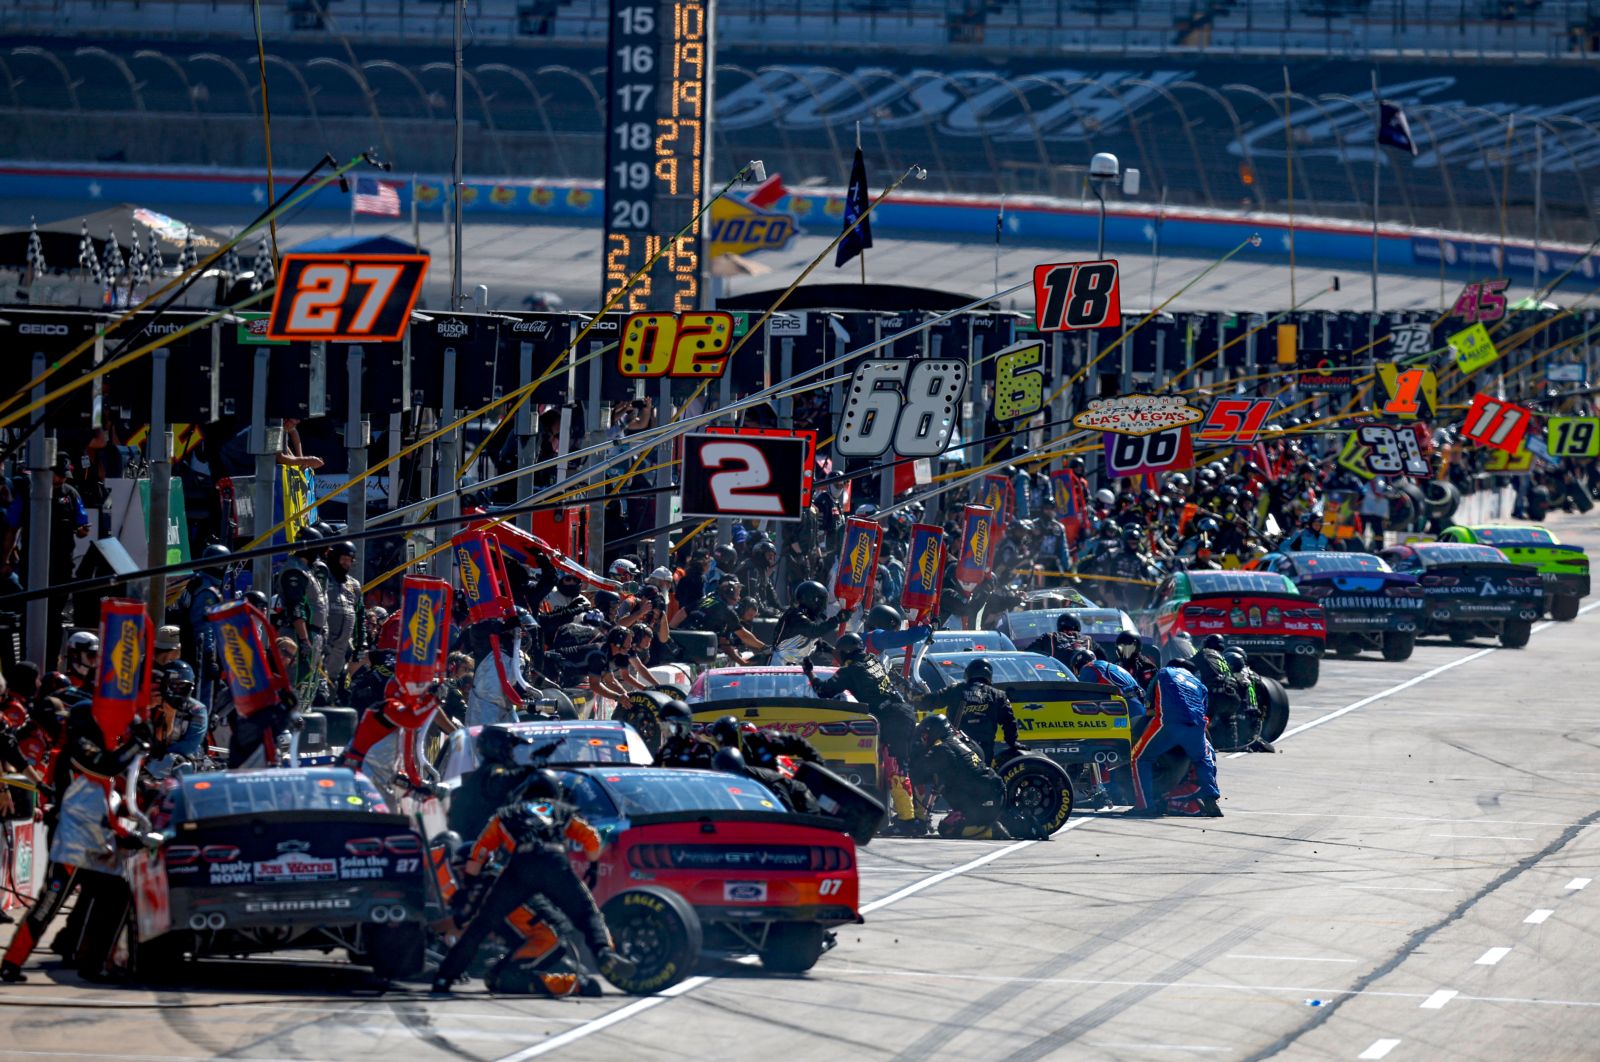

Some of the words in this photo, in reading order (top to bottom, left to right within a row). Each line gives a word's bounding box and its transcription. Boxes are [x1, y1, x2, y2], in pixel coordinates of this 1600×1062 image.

[618, 7, 654, 34] 15
[674, 3, 703, 40] 10
[617, 46, 653, 73] 16
[674, 42, 703, 78] 19
[616, 85, 653, 112] 17
[672, 81, 702, 117] 19
[614, 123, 651, 150] 18
[656, 119, 700, 155] 27
[613, 162, 650, 189] 19
[655, 158, 700, 195] 91
[612, 200, 649, 228] 20
[711, 219, 785, 244] NOCO
[285, 263, 405, 333] 27
[1040, 261, 1118, 330] 18
[1451, 280, 1511, 322] 45
[19, 324, 68, 335] GEICO
[438, 323, 468, 335] BUSCH
[581, 322, 617, 330] GEICO
[772, 320, 801, 329] SRS
[618, 311, 734, 378] 02
[995, 343, 1044, 421] 6
[1383, 368, 1424, 414] 1
[836, 359, 967, 456] 68
[1091, 415, 1120, 425] LAS
[1128, 412, 1187, 422] VEGAS
[1092, 397, 1182, 409] WELCOME
[1200, 399, 1273, 441] 51
[1470, 402, 1523, 445] 11
[1556, 421, 1594, 455] 19
[1112, 430, 1180, 471] 66
[1361, 426, 1429, 474] 31
[700, 441, 785, 514] 2
[852, 533, 870, 584] SUNOCO
[974, 520, 988, 566] SUNOCO
[460, 548, 479, 601] SUNOCO
[922, 537, 938, 590] SUNOCO
[413, 595, 432, 661] SUNOCO
[119, 620, 138, 694] SUNOCO
[222, 624, 256, 689] SUNOCO
[1036, 721, 1075, 729] TRAILER
[1078, 720, 1107, 728] SALES
[1003, 762, 1025, 784] AGLE
[1042, 789, 1071, 831] GOODYE
[209, 860, 252, 874] Apply
[210, 873, 251, 884] NOW!
[340, 856, 365, 869] Join
[367, 856, 389, 867] the
[396, 859, 419, 872] 27
[341, 868, 383, 878] BEST!
[246, 899, 350, 912] CAMARO
[624, 894, 665, 912] EAGLE
[819, 880, 842, 895] 07
